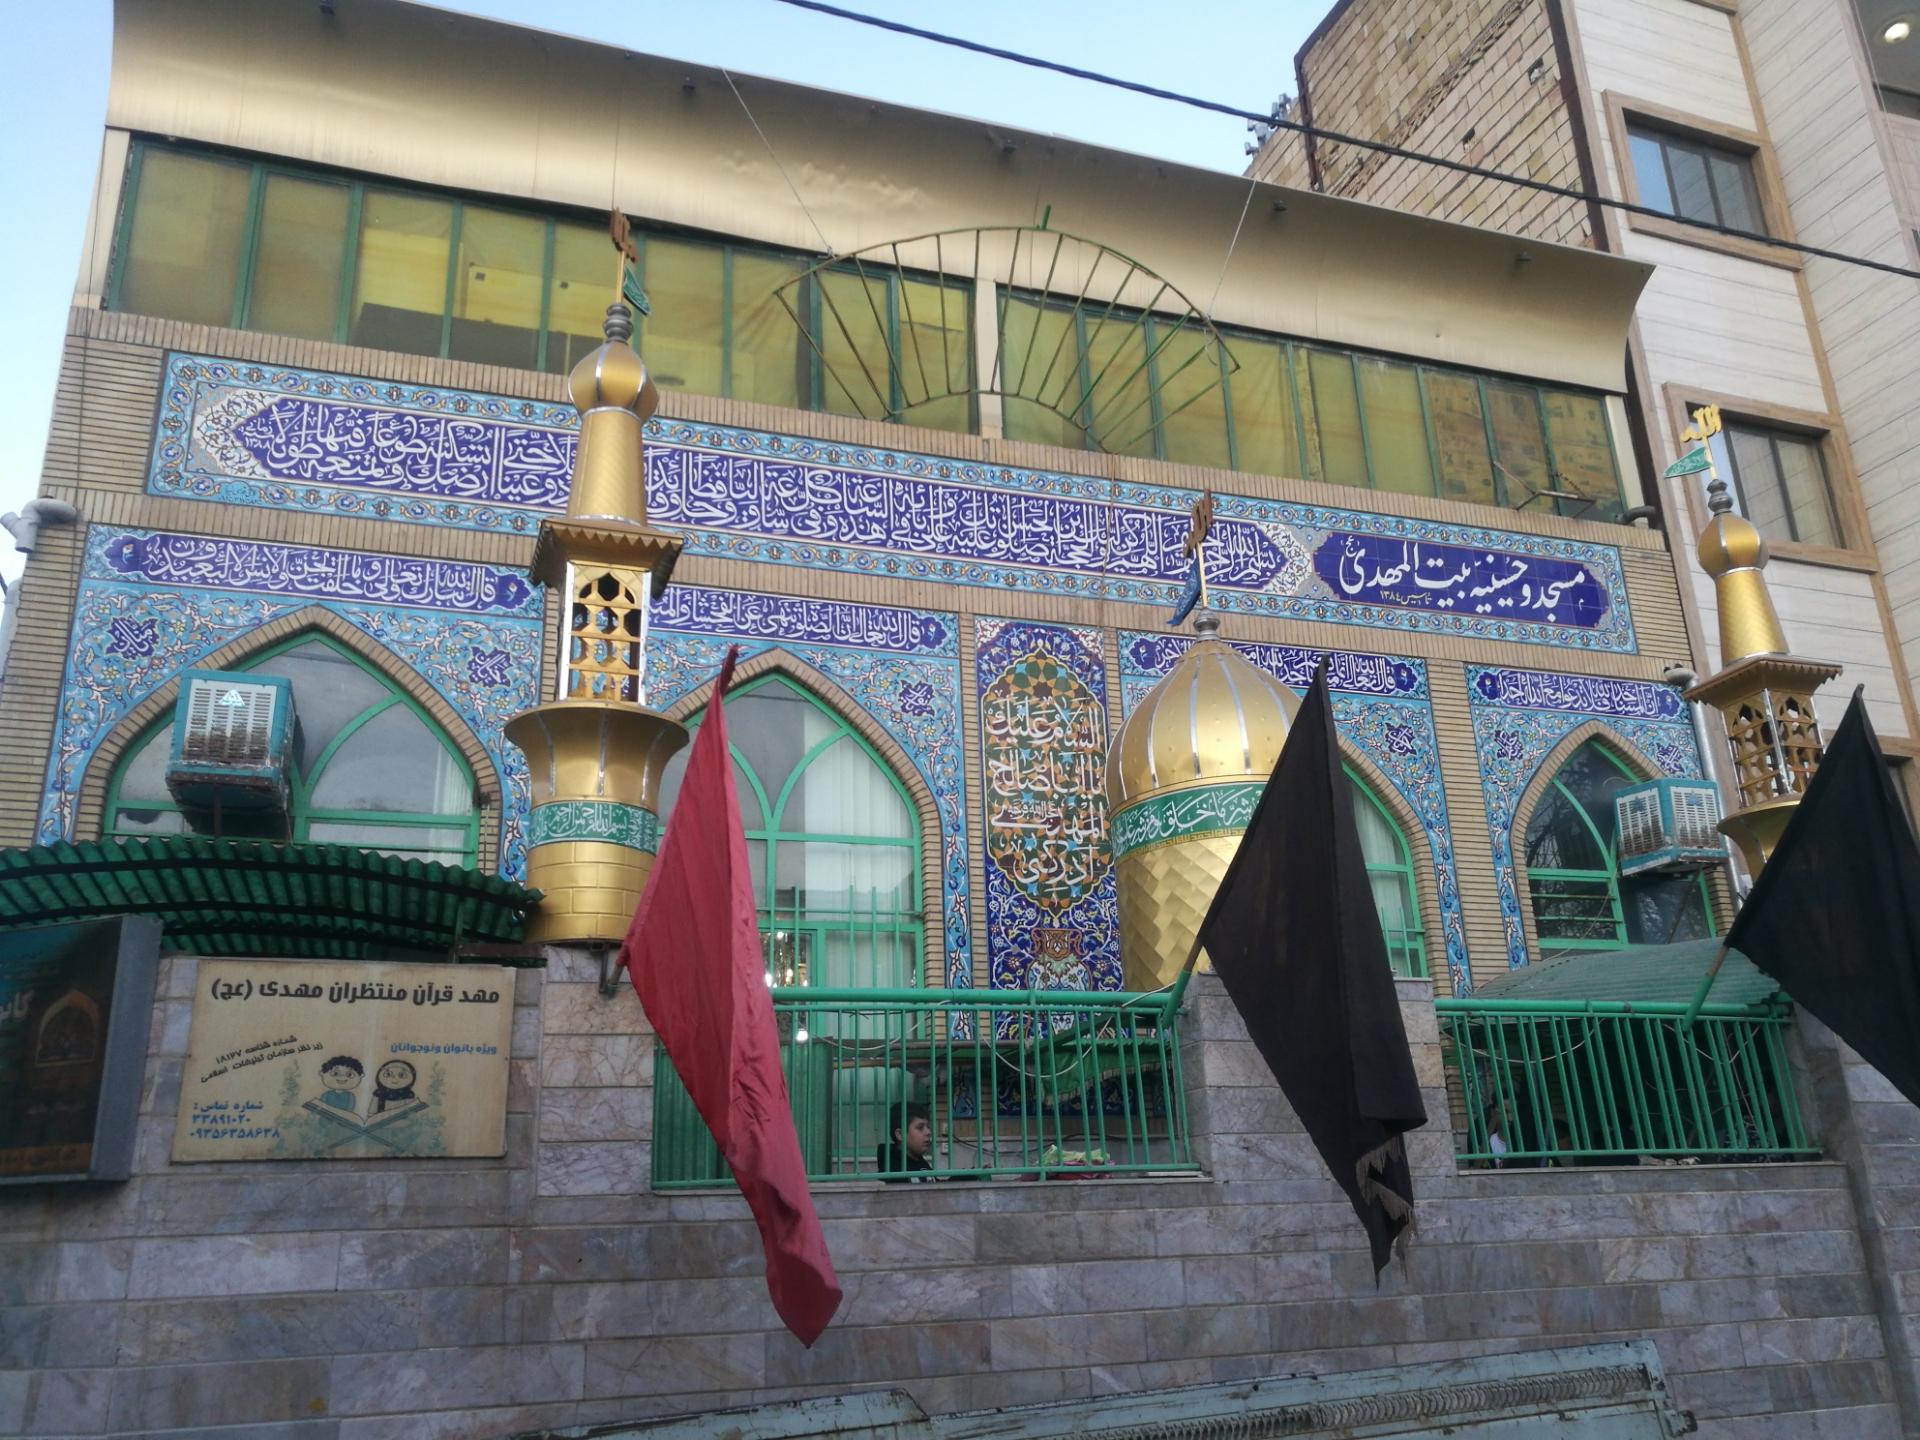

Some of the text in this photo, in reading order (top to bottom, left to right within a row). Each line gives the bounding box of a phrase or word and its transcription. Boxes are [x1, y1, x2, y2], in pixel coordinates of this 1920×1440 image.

[1339, 540, 1419, 595] المهدی
[1415, 557, 1471, 609] بیت
[1470, 554, 1528, 613] حسینیه
[1520, 583, 1532, 607] و
[1532, 570, 1585, 622] مسجد
[1027, 697, 1101, 750] السلام
[988, 749, 1052, 797] صالح
[211, 978, 500, 1006] مهد قرآن منتظران مهدی (عج)
[443, 1042, 473, 1054] بانوان
[476, 1043, 497, 1055] ویژه
[233, 1101, 264, 1112] شماره
